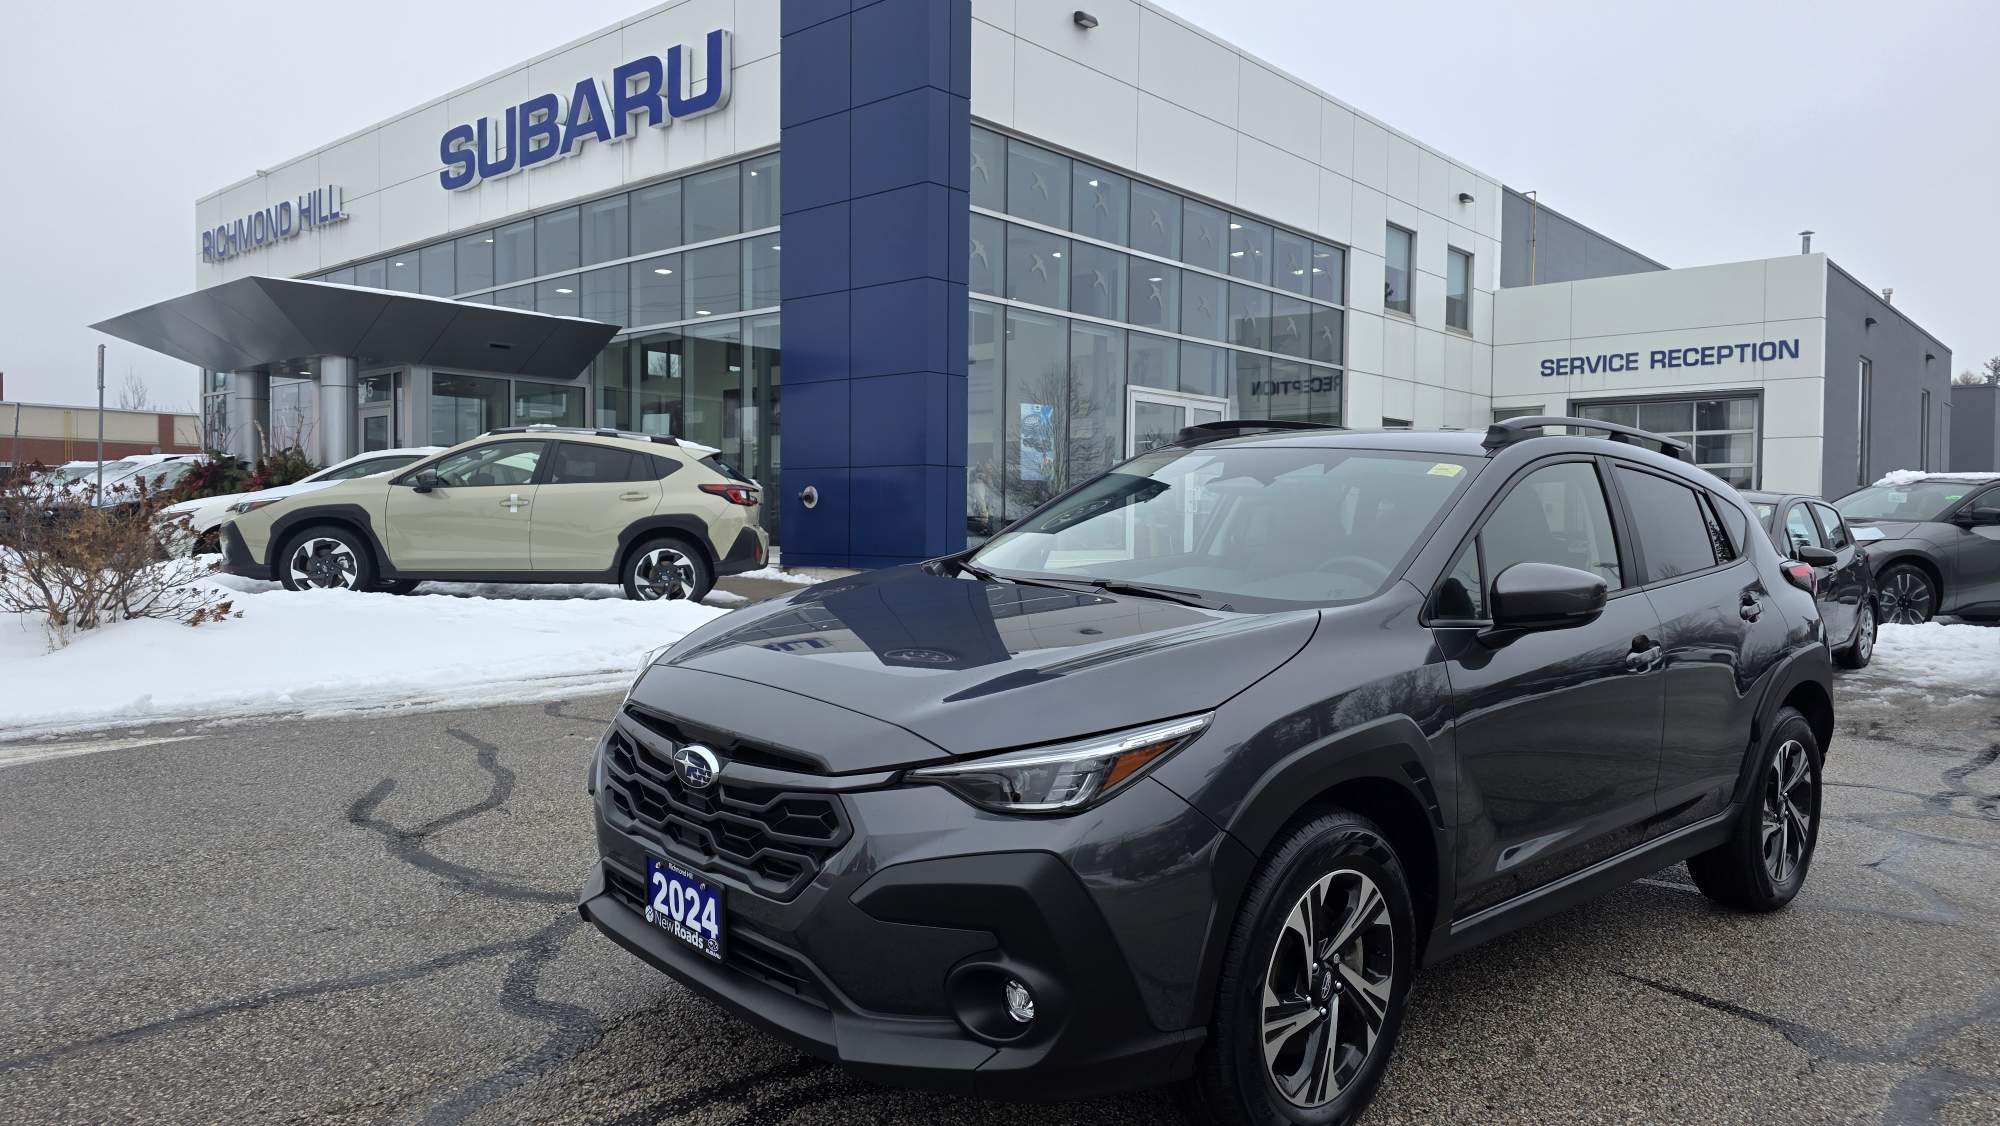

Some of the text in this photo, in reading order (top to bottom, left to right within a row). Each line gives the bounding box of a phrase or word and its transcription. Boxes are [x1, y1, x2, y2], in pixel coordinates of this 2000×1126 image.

[439, 28, 731, 192] SUBARU
[202, 185, 345, 264] RICHMOND HILL
[1540, 339, 1800, 377] SERVICE RECEPTION
[652, 871, 719, 940] 2024
